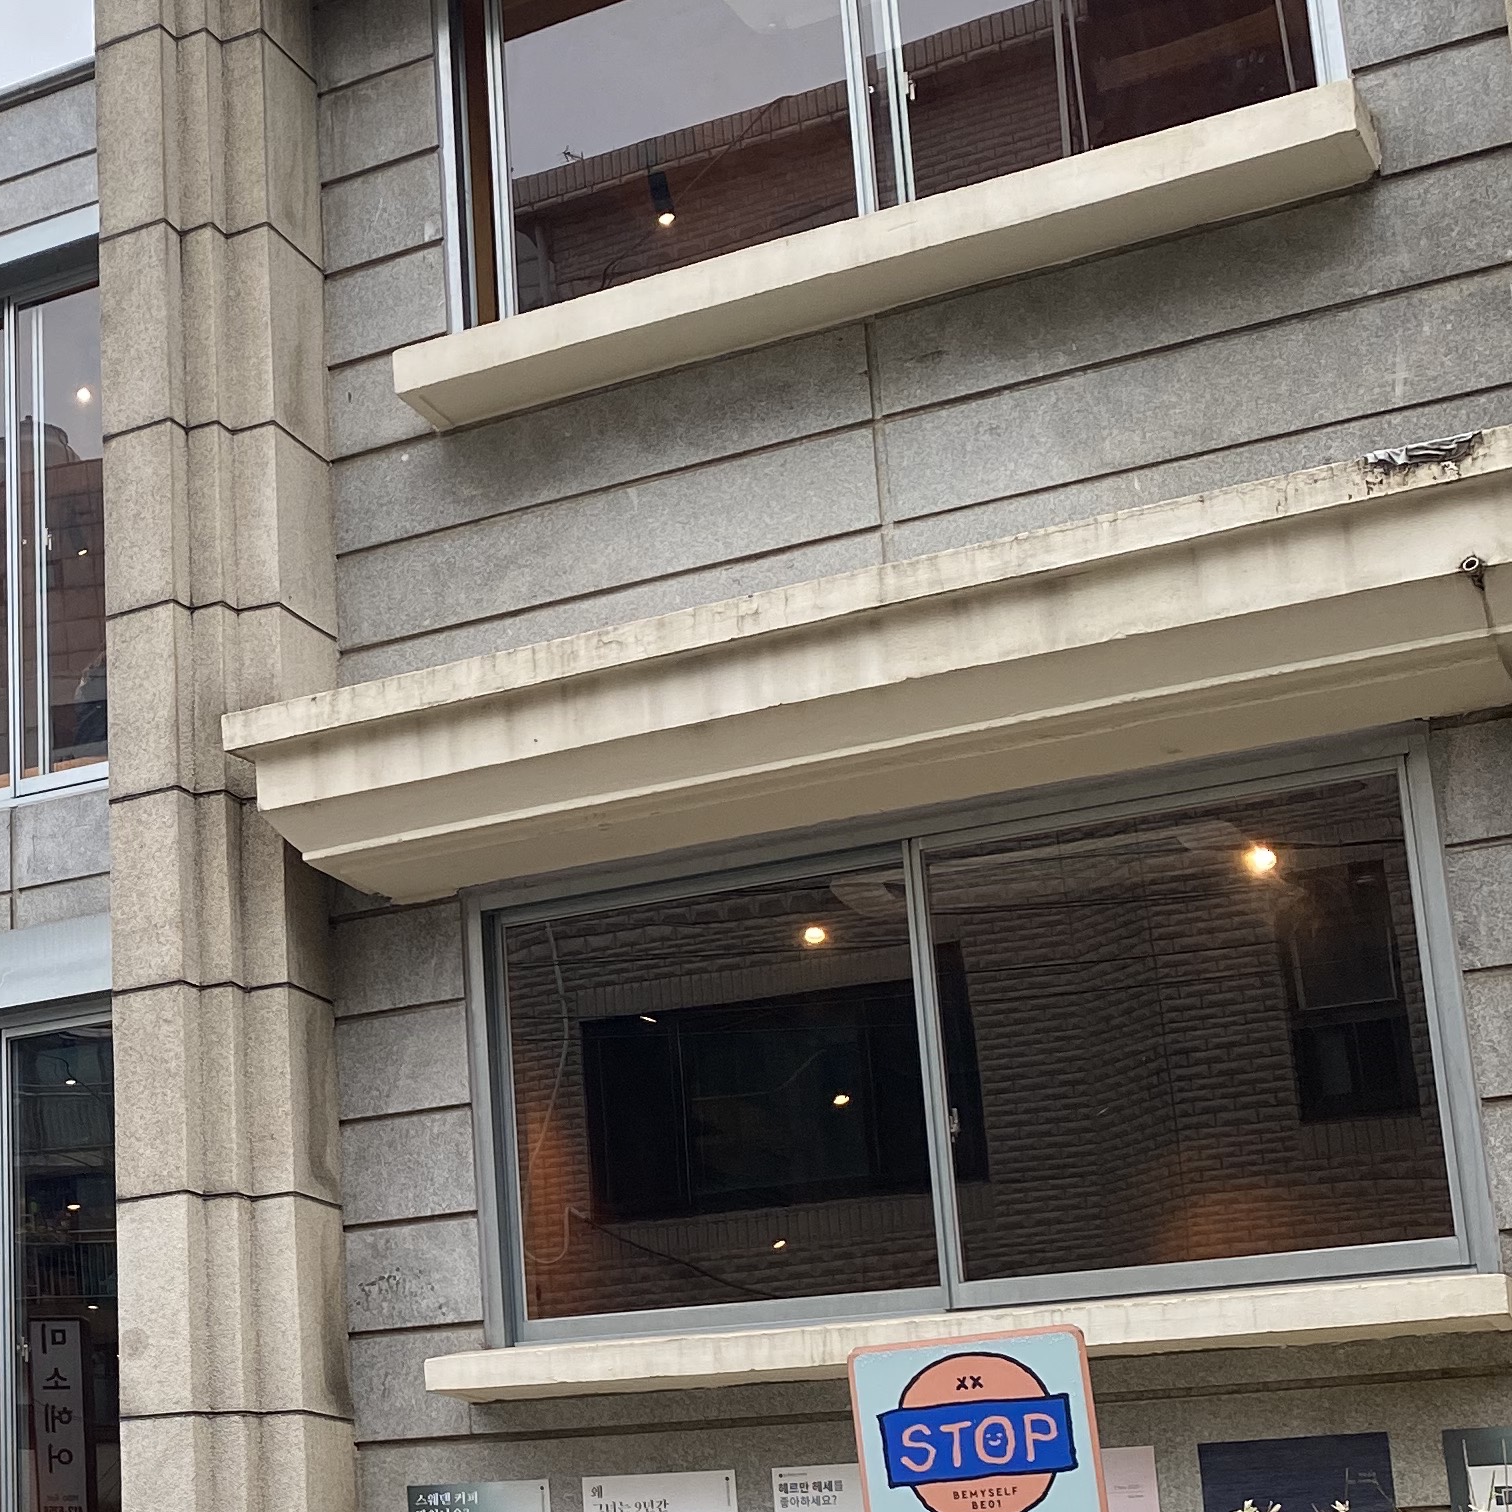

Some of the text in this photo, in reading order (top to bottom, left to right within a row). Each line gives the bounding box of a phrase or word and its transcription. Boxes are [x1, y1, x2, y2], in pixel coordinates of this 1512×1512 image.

[900, 1412, 1059, 1473] STOP
[590, 1484, 603, 1498] 왜
[778, 1479, 844, 1495] 헤르만 헤세를
[952, 1486, 1019, 1501] BEMYSELF
[415, 1490, 478, 1506] 스웨덴 커피
[780, 1494, 838, 1509] 좋아하세요?
